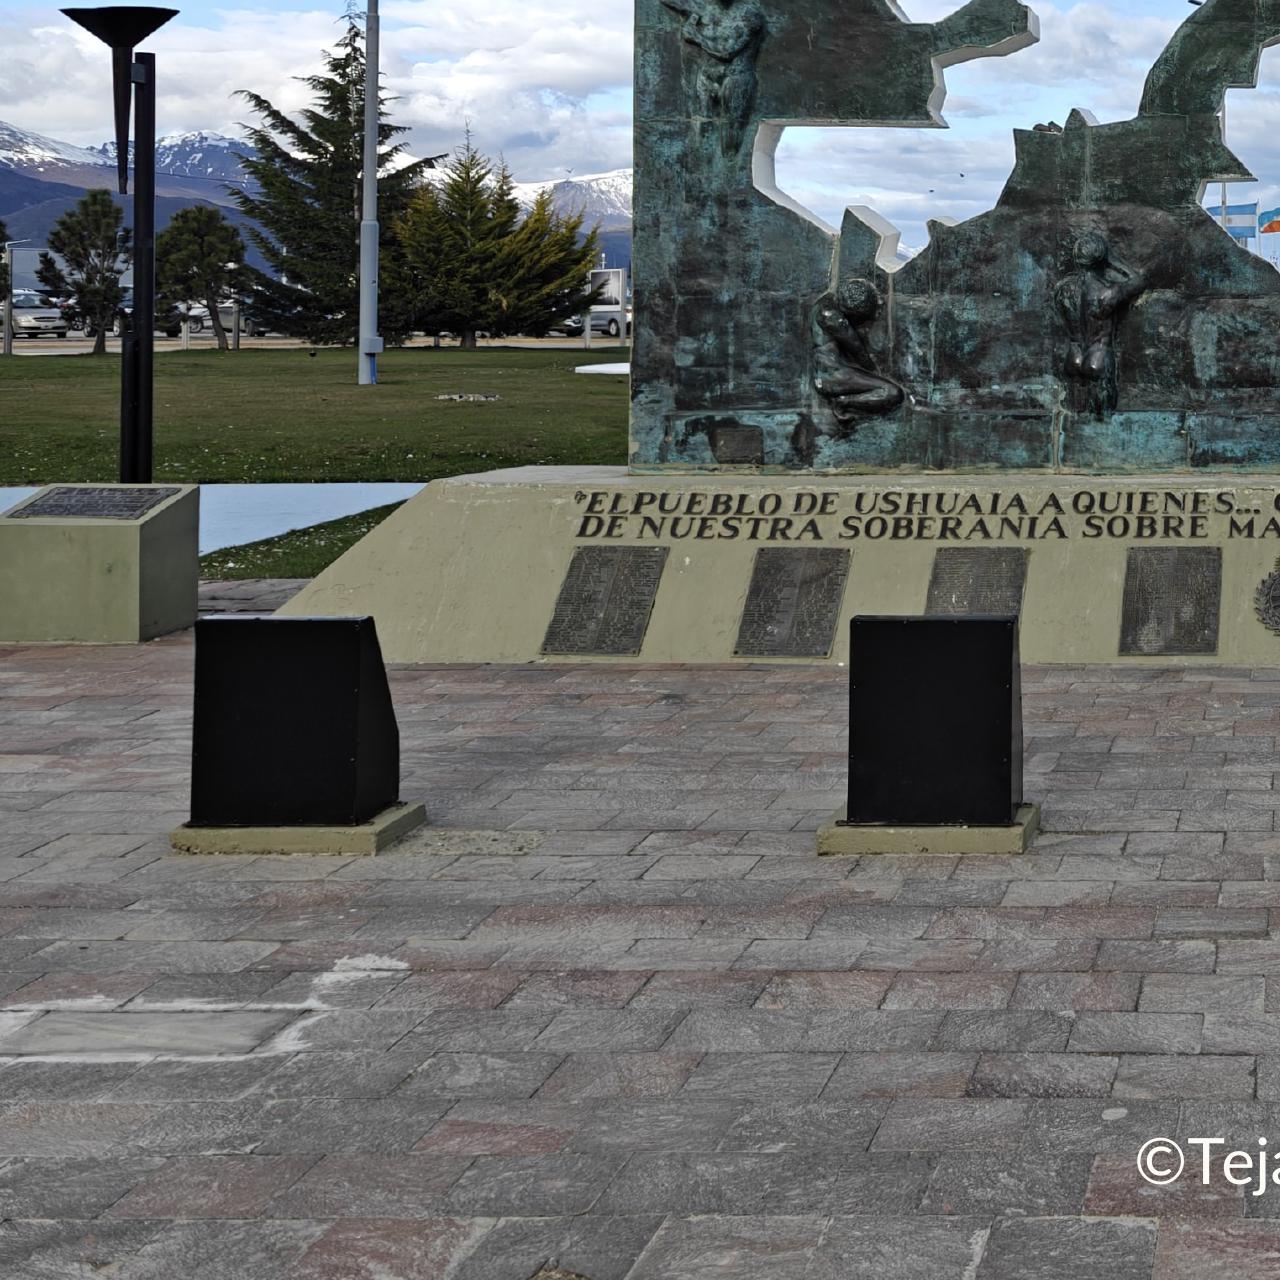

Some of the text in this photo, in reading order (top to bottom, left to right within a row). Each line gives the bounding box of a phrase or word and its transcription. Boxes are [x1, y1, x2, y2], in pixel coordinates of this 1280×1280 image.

[790, 492, 839, 516] DE
[855, 491, 1028, 516] USHUAIA
[1038, 492, 1065, 515] A
[576, 515, 628, 538] DE
[636, 516, 823, 540] NUESTRA
[838, 516, 1069, 540] SOBERANIA
[1082, 515, 1209, 539] SOBRE
